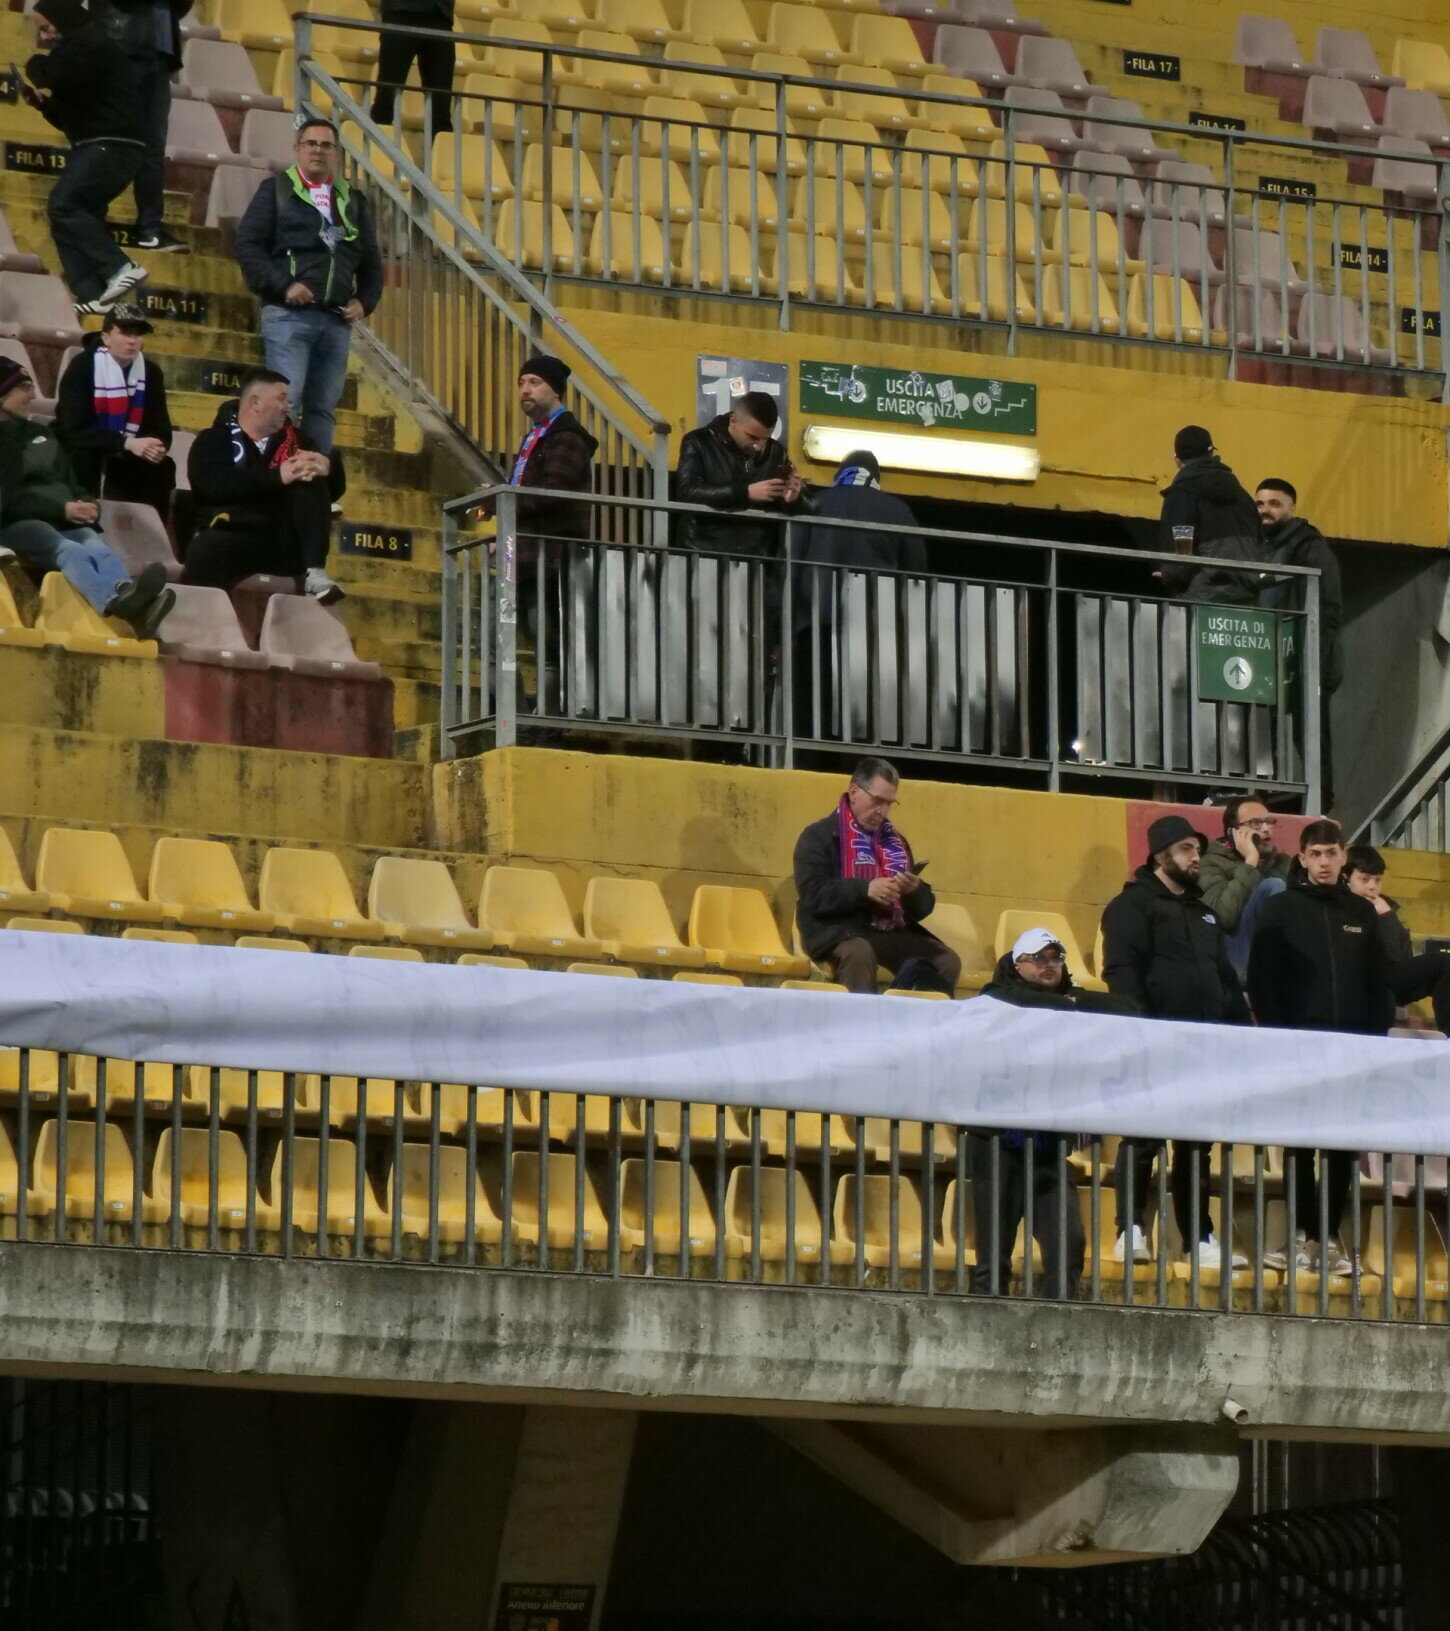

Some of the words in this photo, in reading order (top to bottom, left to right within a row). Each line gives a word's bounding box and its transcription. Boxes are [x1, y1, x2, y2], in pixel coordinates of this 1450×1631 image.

[1132, 58, 1156, 72] FILA
[1159, 61, 1173, 73] 17
[15, 151, 45, 167] FILA
[50, 155, 67, 169] 13
[1267, 184, 1290, 195] FILA
[1294, 187, 1308, 197] 15
[112, 230, 129, 245] 12
[1340, 250, 1361, 264] FILA
[1367, 254, 1381, 267] 14
[147, 295, 177, 312] FILA
[180, 300, 197, 315] 11
[1411, 316, 1434, 331] FA
[211, 372, 241, 389] FILA
[886, 378, 935, 398] USCITA
[876, 397, 963, 420] EMERGENZA
[355, 533, 385, 550] FILA
[388, 536, 398, 551] 8
[1208, 617, 1249, 633] USCITA
[1253, 621, 1265, 634] DI
[1202, 632, 1271, 650] EMERGENZA
